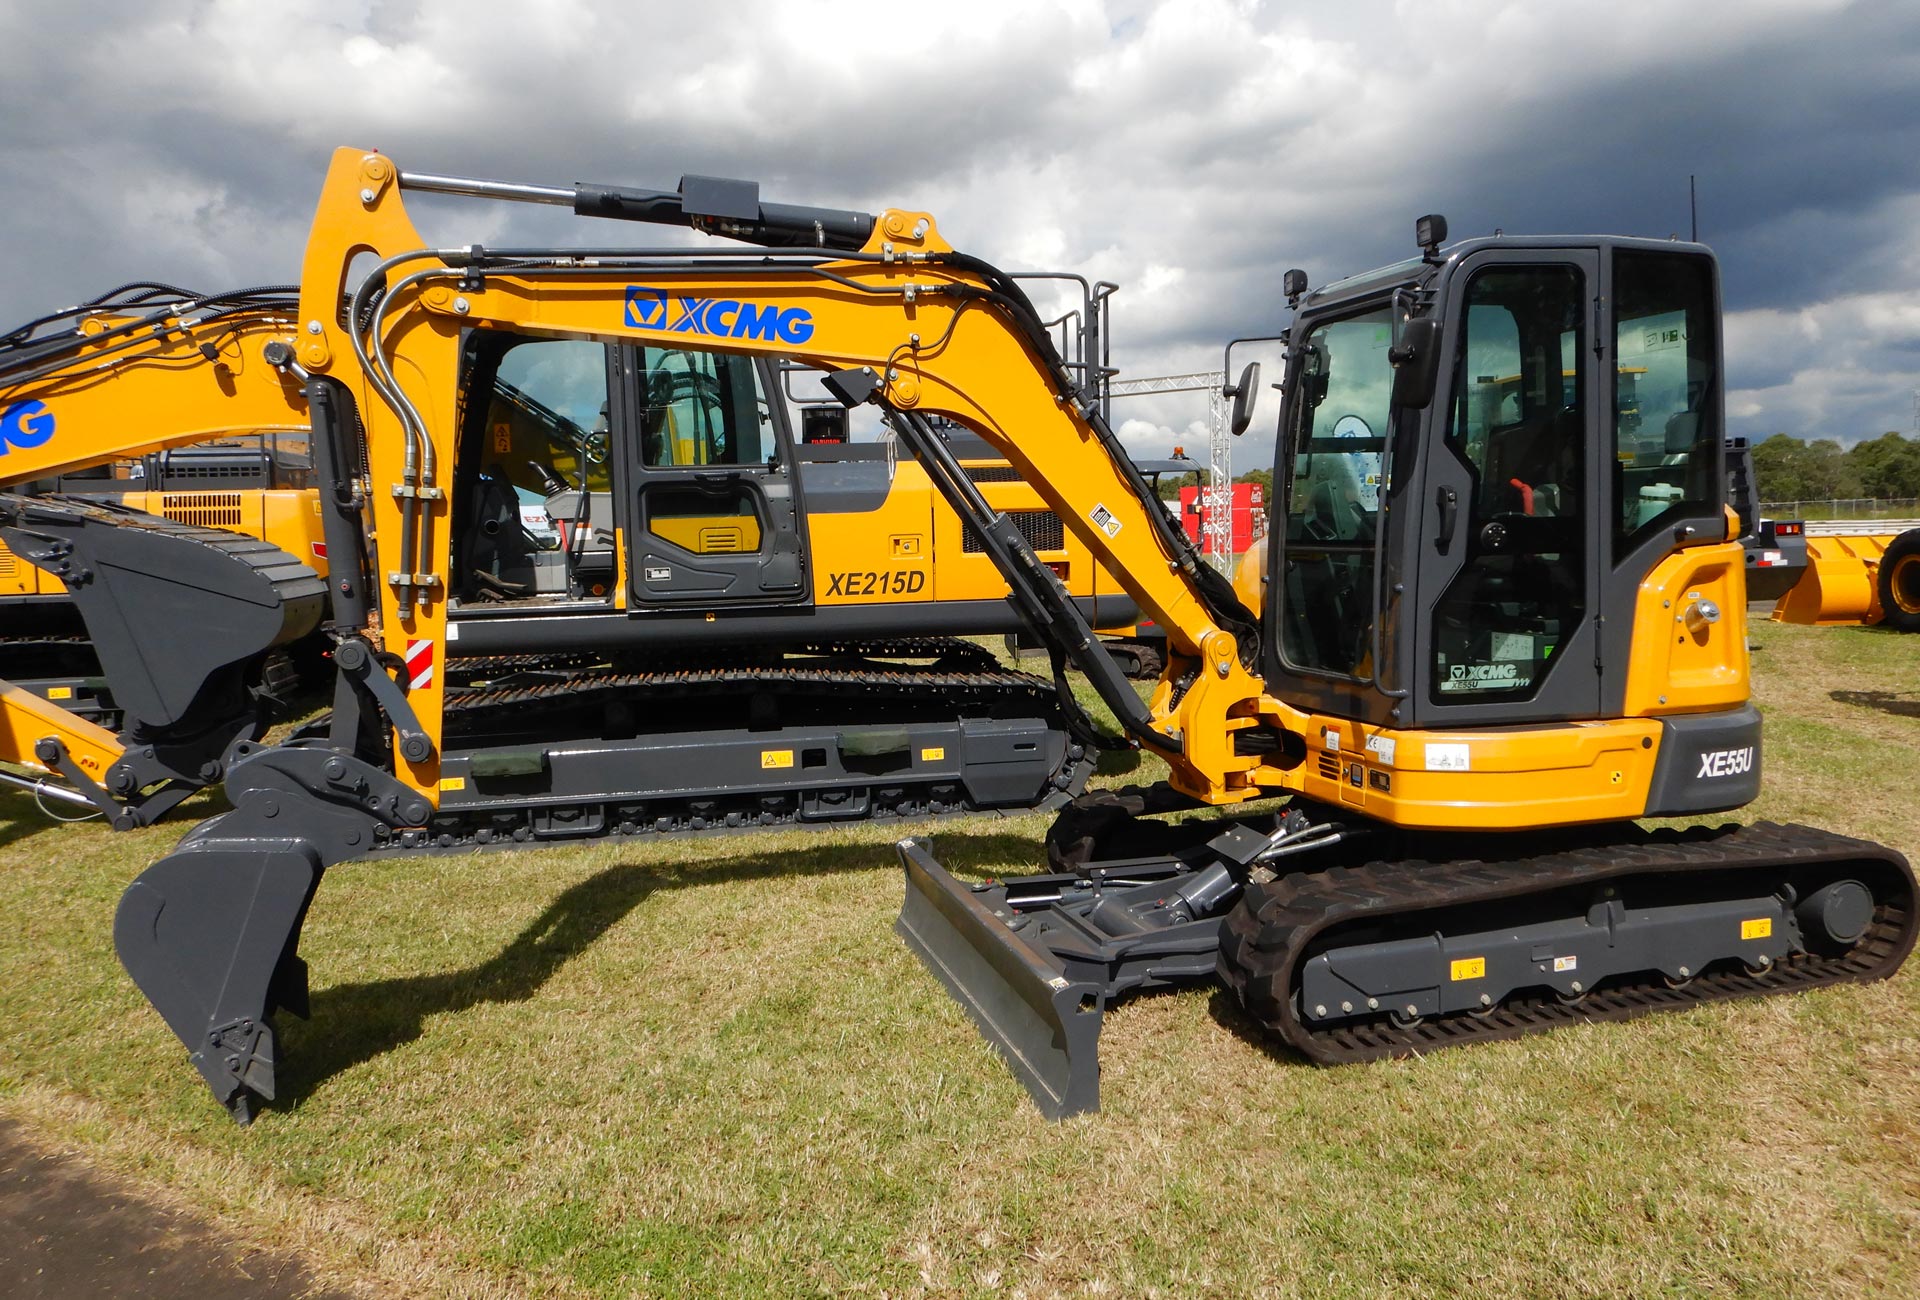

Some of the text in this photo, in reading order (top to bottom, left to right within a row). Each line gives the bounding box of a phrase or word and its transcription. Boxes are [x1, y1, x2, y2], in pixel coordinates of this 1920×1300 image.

[667, 296, 815, 345] XCMG
[825, 570, 925, 597] XE215D
[1451, 681, 1479, 690] XE55U
[1466, 664, 1518, 681] XCMG
[1696, 746, 1754, 779] XE55U
